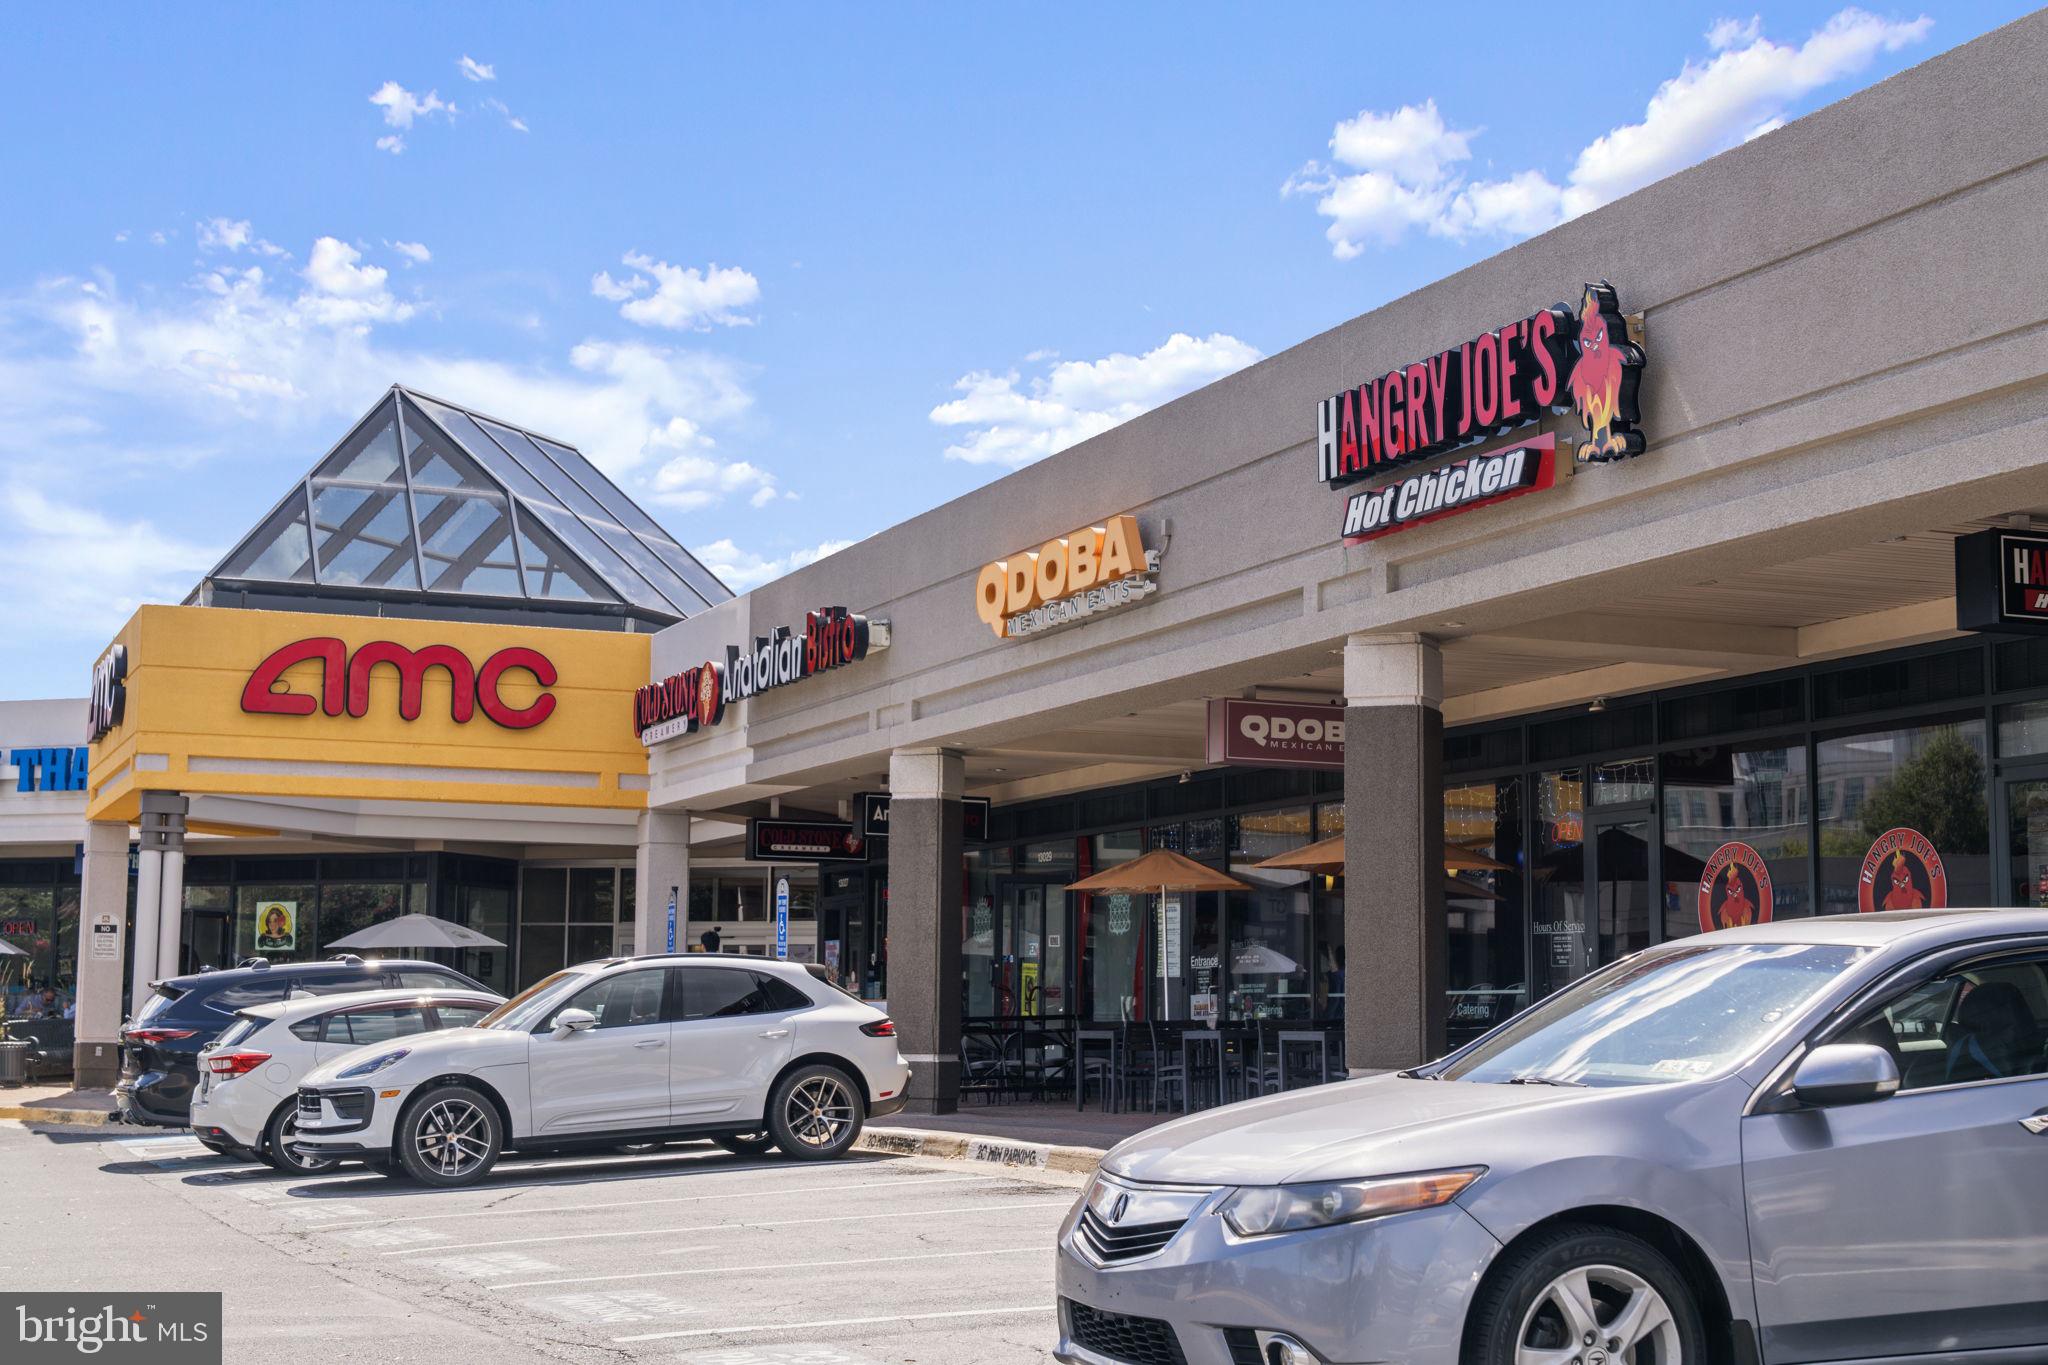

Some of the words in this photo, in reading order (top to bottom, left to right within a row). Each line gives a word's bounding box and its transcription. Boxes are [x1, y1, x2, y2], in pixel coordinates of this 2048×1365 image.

[1316, 349, 1450, 483] HANGRY
[1457, 308, 1558, 436] JOE'S
[1343, 483, 1397, 537] Hot
[1396, 448, 1526, 520] Chicken
[976, 515, 1139, 638] QDOBA
[2014, 547, 2048, 586] HA
[1007, 596, 1080, 636] MEXICAN
[1087, 579, 1131, 609] EATS
[722, 627, 802, 705] Anatolian
[633, 684, 661, 739] COLD
[661, 668, 698, 720] STONE
[1270, 740, 1332, 751] MEXICAN
[760, 828, 796, 847] COLD
[799, 830, 842, 849] STONE
[1862, 832, 1906, 885] HANGRY
[1911, 834, 1942, 879] JOE'S
[1701, 847, 1738, 894] HANGRY
[1743, 852, 1768, 889] JOE'S
[1533, 921, 1552, 932] Hours
[1554, 920, 1563, 931] Of
[1191, 955, 1218, 967] Entrance
[1457, 1003, 1489, 1017] Catering
